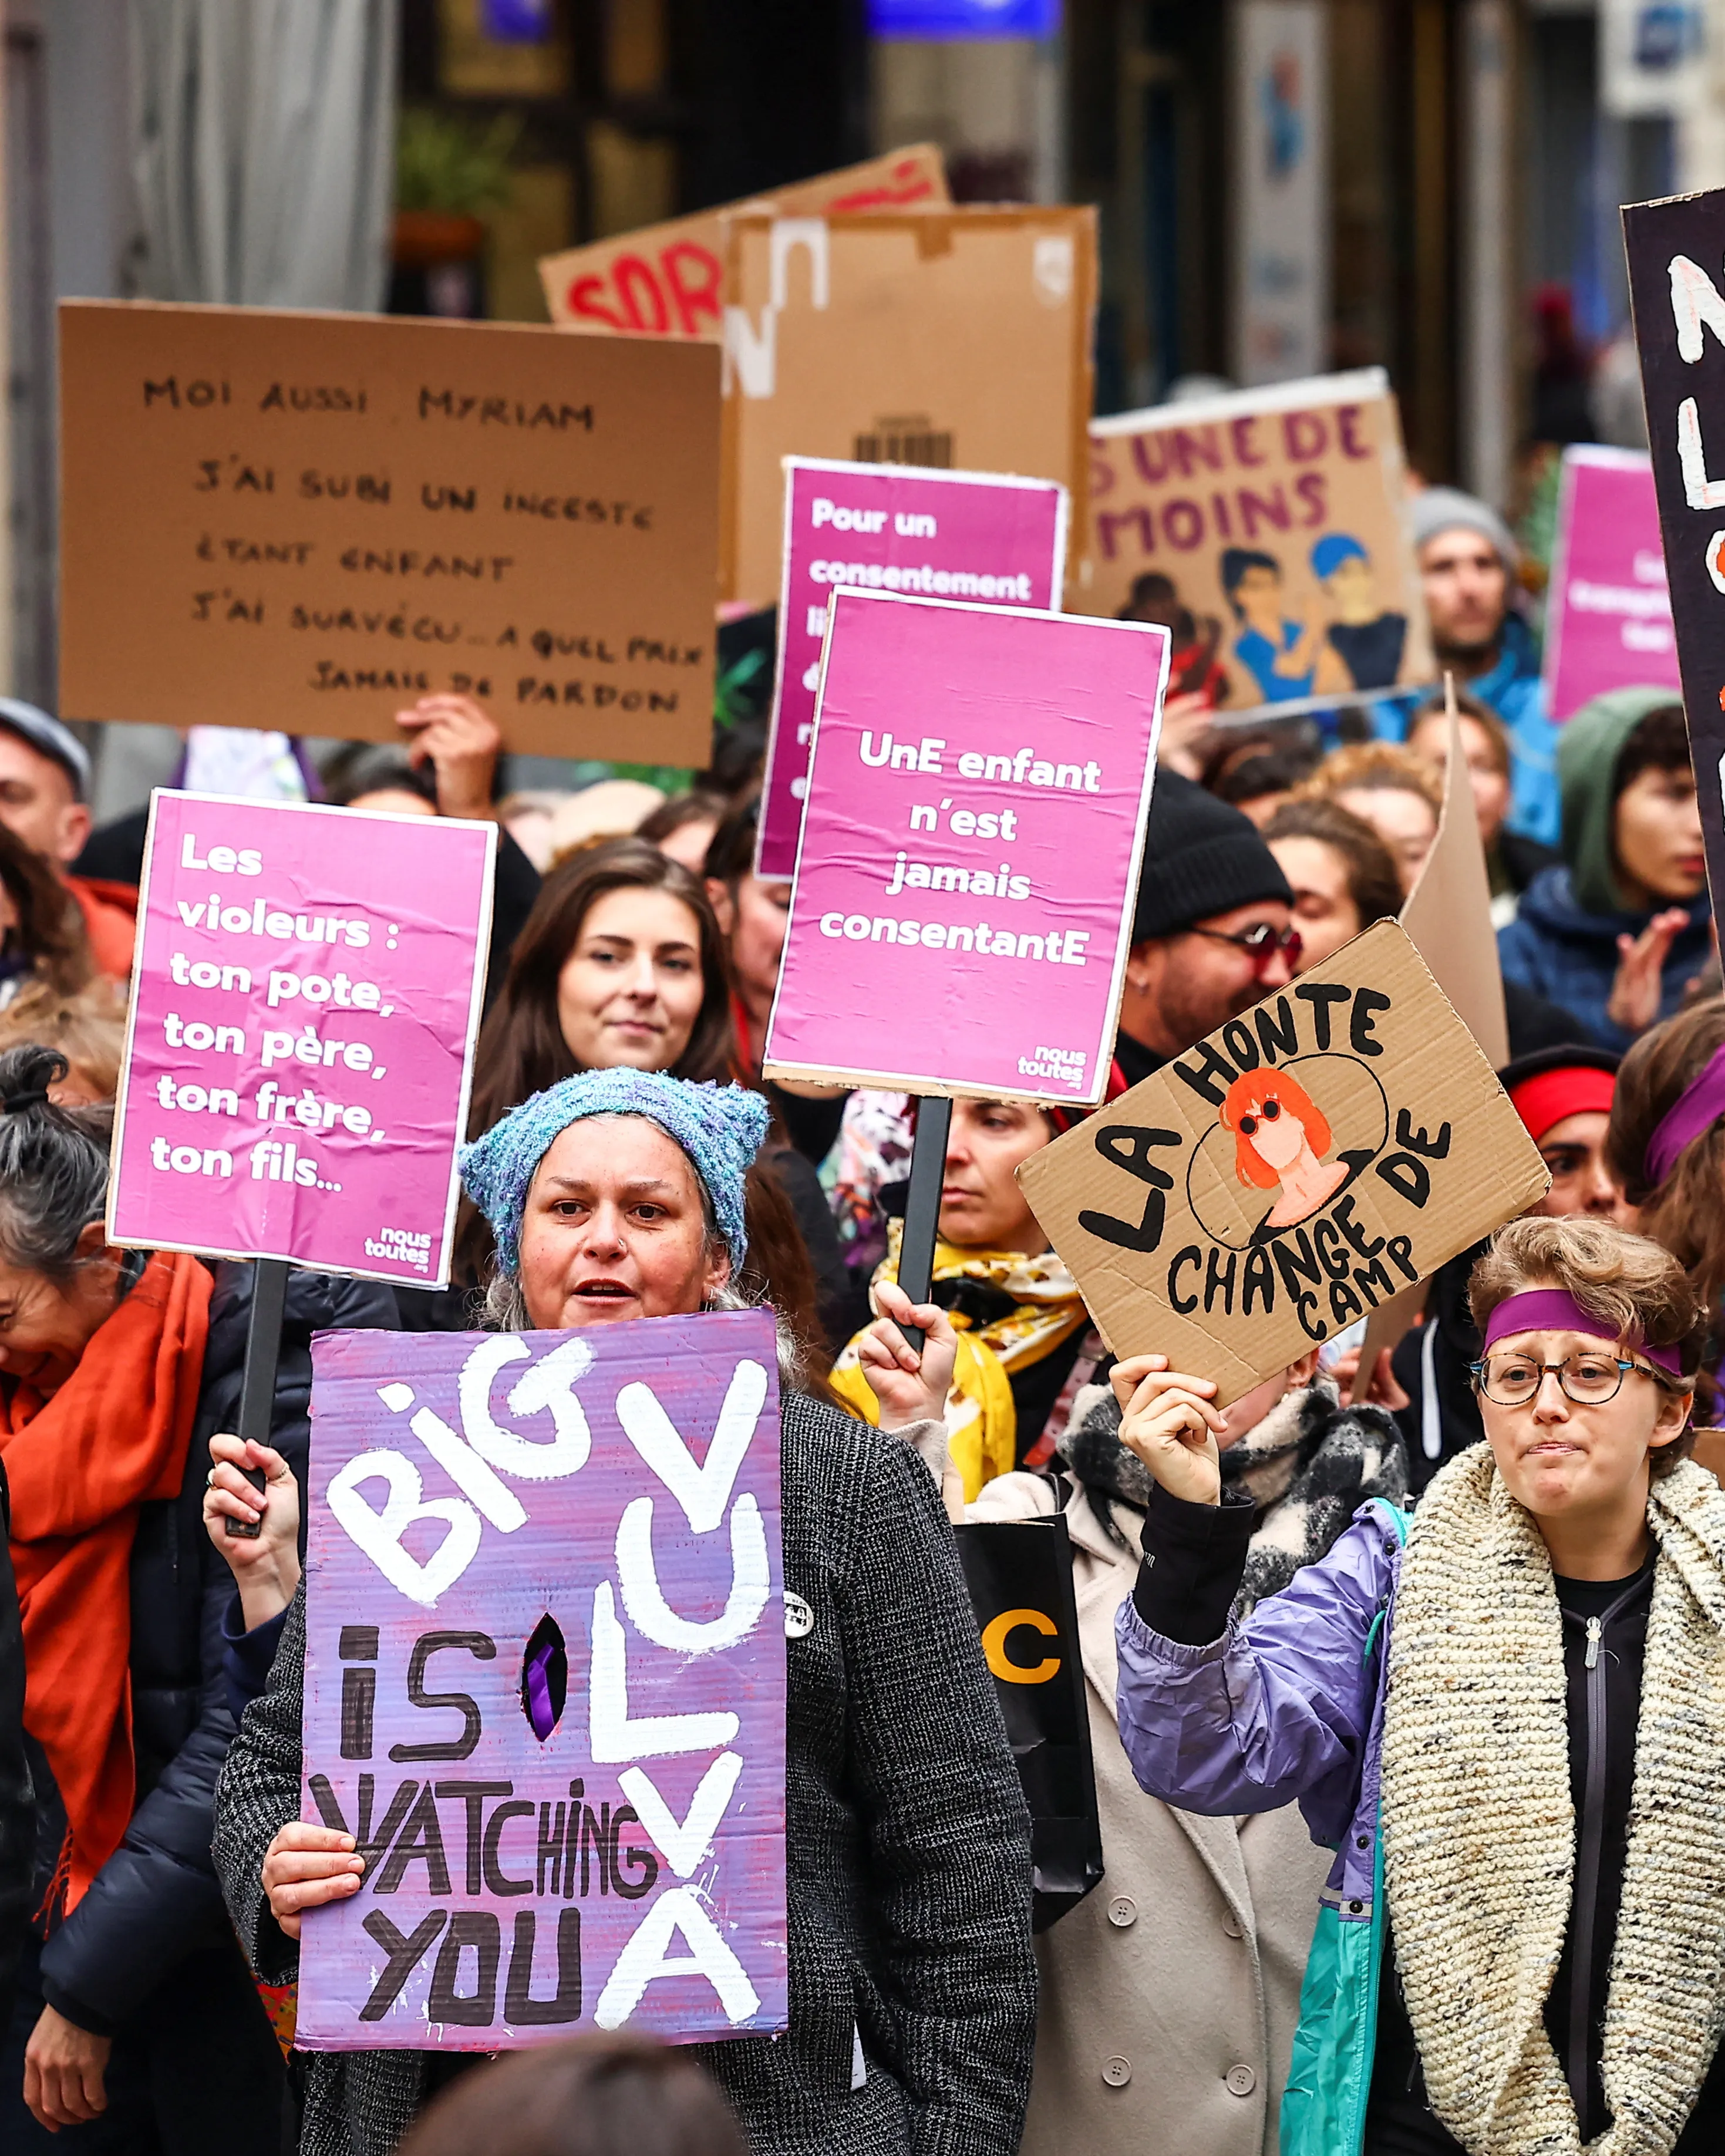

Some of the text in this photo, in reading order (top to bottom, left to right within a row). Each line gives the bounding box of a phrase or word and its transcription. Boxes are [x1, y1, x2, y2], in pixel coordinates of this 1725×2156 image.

[142, 374, 595, 433] MOI AUSSI MYRIAM
[1131, 414, 1265, 484] UNE
[1282, 403, 1375, 464] DE
[194, 453, 275, 494] J'AI
[420, 484, 477, 513] UN
[811, 498, 937, 538] Pour un
[1096, 471, 1328, 561] MOINS
[339, 547, 514, 582] ENFANT
[808, 559, 1032, 602] consentement
[193, 587, 264, 625] J'AI
[530, 628, 614, 663] QUEL
[626, 635, 703, 666] PRIX
[450, 672, 491, 698] DE
[517, 676, 679, 713] PARDON
[860, 731, 946, 773] UnE
[958, 748, 1101, 793] enfant
[181, 834, 262, 876] Les
[885, 851, 1031, 900] jamais
[177, 893, 370, 948] violeurs
[820, 912, 1090, 966] consentantE
[170, 952, 395, 1018] ton pote,
[163, 1013, 386, 1079] ton père,
[1018, 1056, 1084, 1082] toutes
[1034, 1046, 1087, 1066] nous
[157, 1075, 386, 1143] ton frère,
[1078, 983, 1392, 1253] LA HONTE
[150, 1137, 233, 1177] ton
[380, 1227, 432, 1249] nous
[1167, 1108, 1453, 1316] CHANGE DE
[364, 1237, 430, 1264] toutes
[1296, 1235, 1419, 1342] CAMP
[589, 1358, 771, 2032] VULVA
[358, 1906, 583, 2027] YOU
